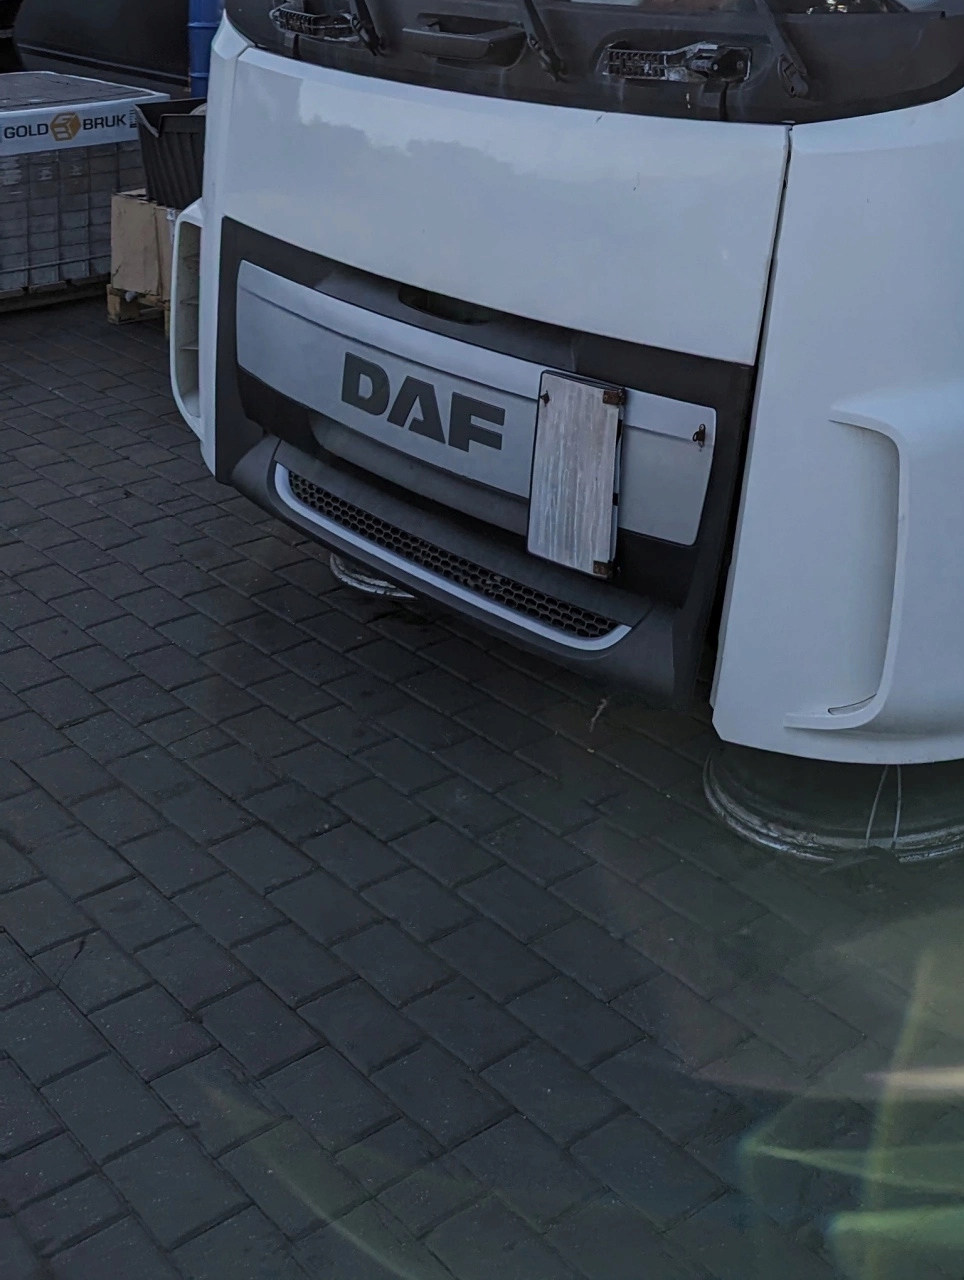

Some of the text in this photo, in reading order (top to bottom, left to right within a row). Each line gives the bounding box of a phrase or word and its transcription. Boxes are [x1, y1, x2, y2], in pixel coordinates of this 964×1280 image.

[4, 123, 49, 139] GOLD
[82, 114, 127, 131] BRUK
[341, 351, 506, 453] DAF
